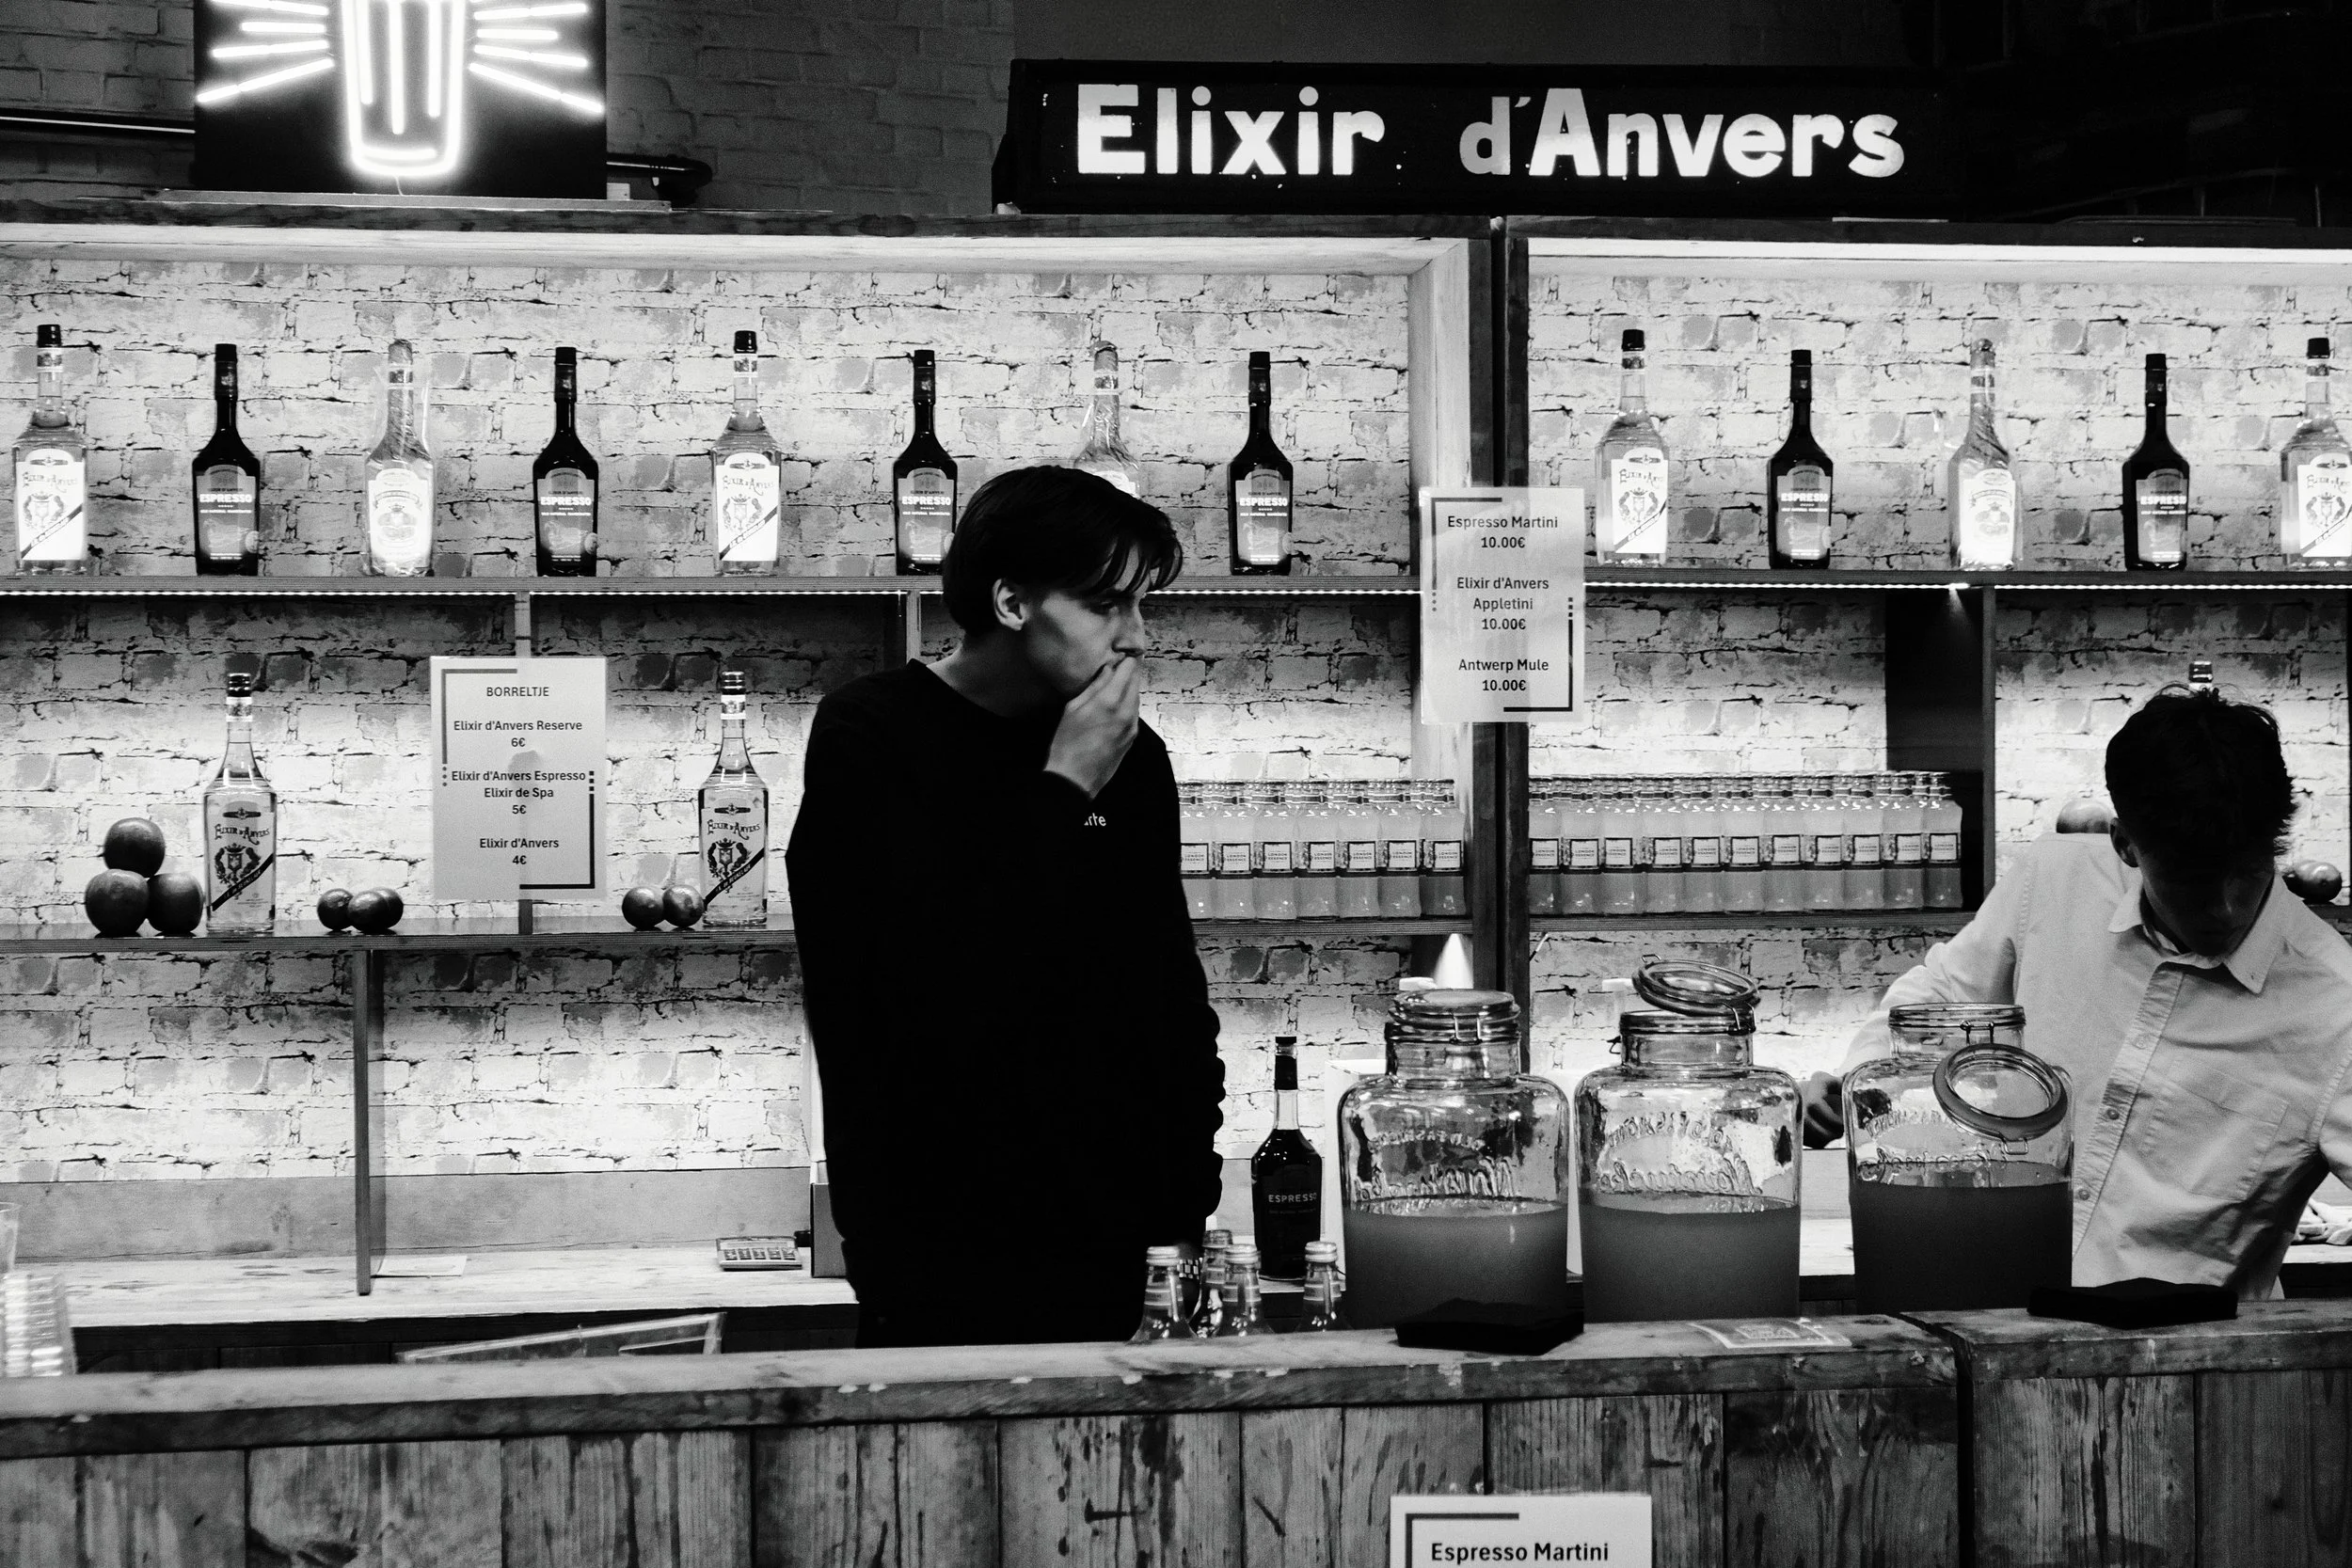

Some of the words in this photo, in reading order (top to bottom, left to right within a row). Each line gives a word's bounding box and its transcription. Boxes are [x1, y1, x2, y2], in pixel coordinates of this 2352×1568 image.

[1077, 84, 1386, 176] Elixir
[1459, 87, 1905, 182] d'Anvers
[199, 494, 253, 503] ESPRESSO
[540, 496, 592, 506] ESPRESSO
[901, 496, 952, 506] ESPRESSO
[1239, 497, 1288, 507] ESPRESSO
[1781, 493, 1829, 502] ESPRESSO
[1447, 515, 1508, 530] Espresso
[1511, 515, 1558, 529] Martini
[1480, 536, 1526, 549] 10.00€
[1456, 577, 1490, 590] Elixir
[1493, 577, 1549, 590] d'Anvers
[1472, 597, 1534, 613] Appletini
[1481, 618, 1527, 631] 10.00€
[1458, 658, 1514, 673] Antwerp
[1518, 658, 1549, 672] Mule
[485, 686, 550, 697] BORRELTJE
[1482, 679, 1527, 692] 10.00€
[453, 720, 484, 731] Elixir
[485, 720, 534, 731] d'Anvers
[537, 720, 583, 731] Reserve
[511, 737, 527, 748] 6€
[451, 770, 480, 782] Elixir
[483, 770, 532, 782] d'Anvers
[534, 770, 586, 783] Espresso
[484, 787, 513, 799] Elixir
[516, 787, 531, 799] de
[532, 787, 554, 800] Spa
[512, 804, 528, 816] 5€
[479, 837, 508, 848] Elixir
[511, 837, 560, 848] d'Anvers
[512, 854, 528, 865] 4€
[1431, 1542, 1528, 1566] Espresso
[1534, 1542, 1609, 1561] Martini
